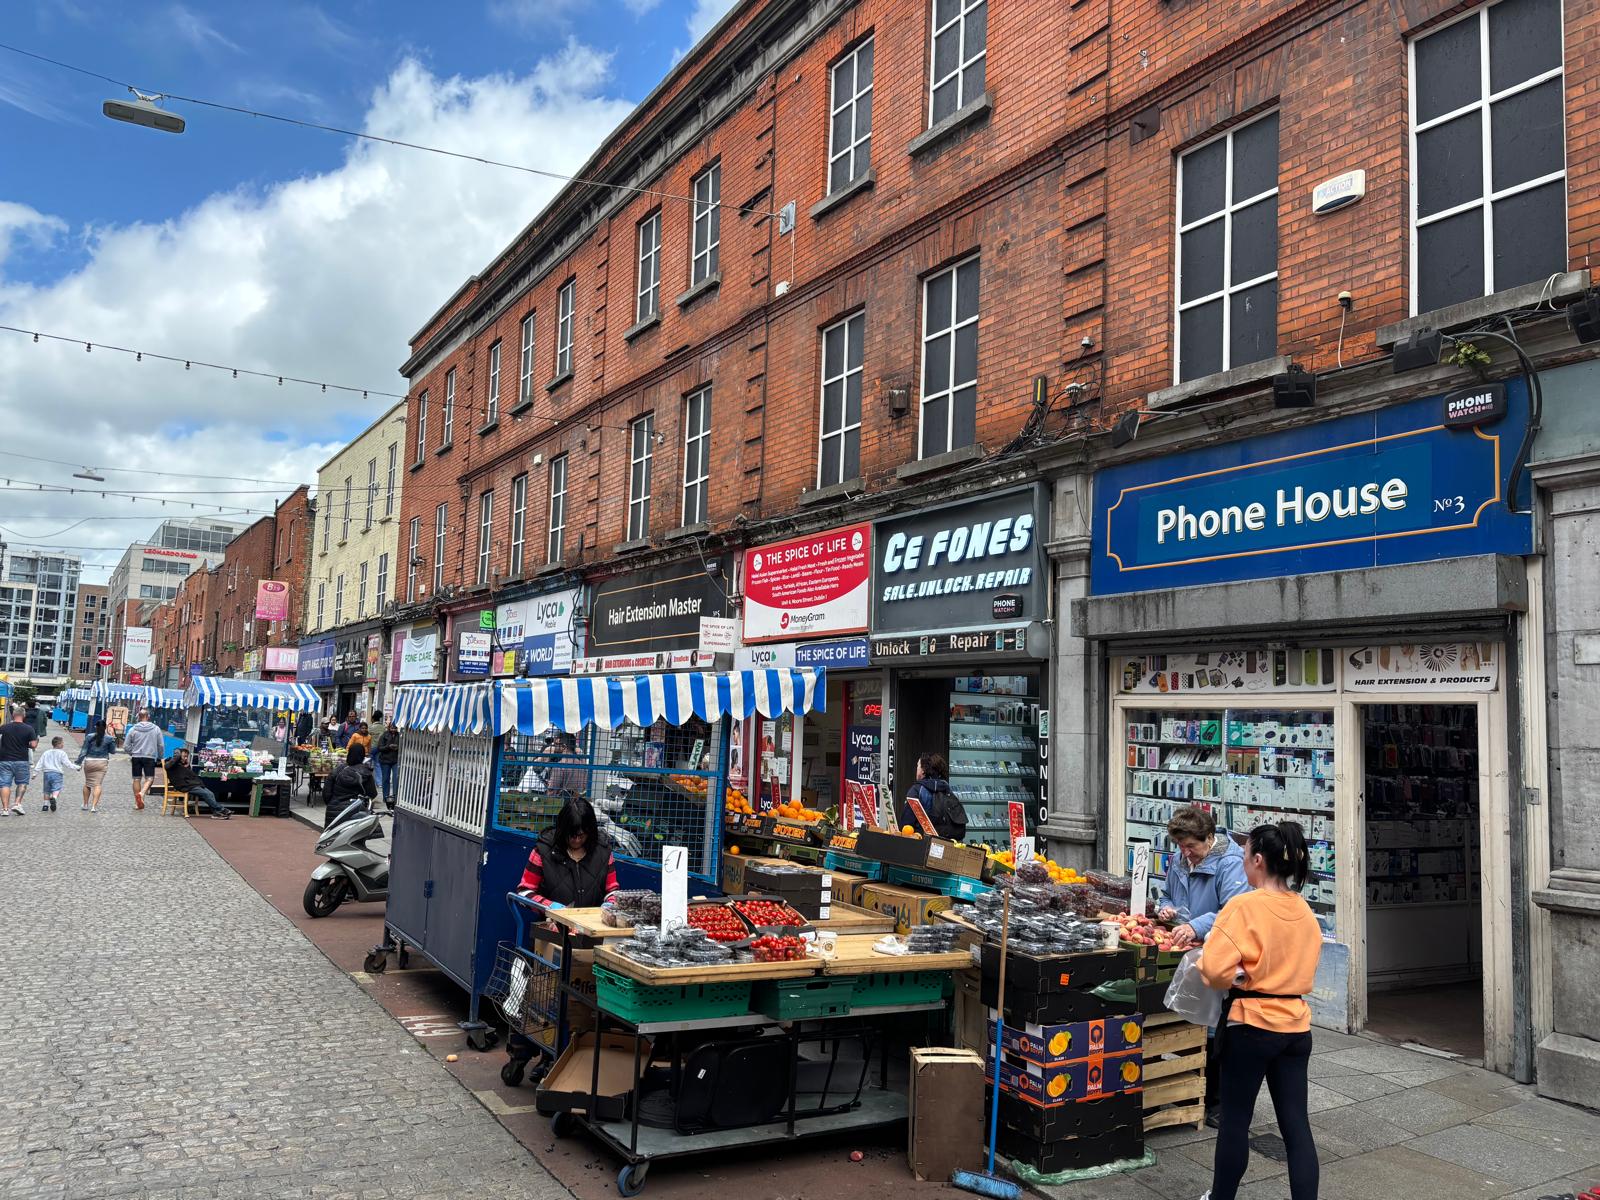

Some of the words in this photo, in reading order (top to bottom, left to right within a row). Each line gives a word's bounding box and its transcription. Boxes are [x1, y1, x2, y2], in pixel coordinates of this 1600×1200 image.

[1448, 393, 1492, 412] PHONE
[1448, 405, 1481, 419] WATCH
[1157, 501, 1265, 544] Phone
[1276, 478, 1408, 527] House
[928, 513, 1035, 567] FONES
[143, 548, 180, 557] LEONARDO
[766, 552, 783, 565] THE
[785, 546, 810, 562] SPICE
[811, 542, 824, 556] OF
[827, 538, 847, 553] LIFE
[608, 608, 625, 625] Hair
[625, 601, 667, 623] Extension
[669, 597, 702, 617] Master
[993, 599, 1016, 607] PHONE
[537, 601, 558, 624] Lyca
[790, 612, 825, 624] MoneyGram
[876, 640, 910, 656] Unlock
[950, 632, 989, 651] Repair
[530, 647, 553, 663] WORLD
[751, 650, 771, 665] Lyca
[797, 650, 811, 662] THE
[813, 648, 834, 662] SPICE
[836, 647, 847, 659] OF
[849, 645, 866, 659] LIFE
[1440, 676, 1491, 684] PRODUCTS
[864, 705, 882, 716] OPE
[851, 731, 873, 749] Lyca
[760, 798, 773, 811] Lyc
[664, 850, 682, 873] €1
[1134, 866, 1146, 885] €1
[1030, 1042, 1044, 1051] PALM
[1030, 1080, 1042, 1088] PALM
